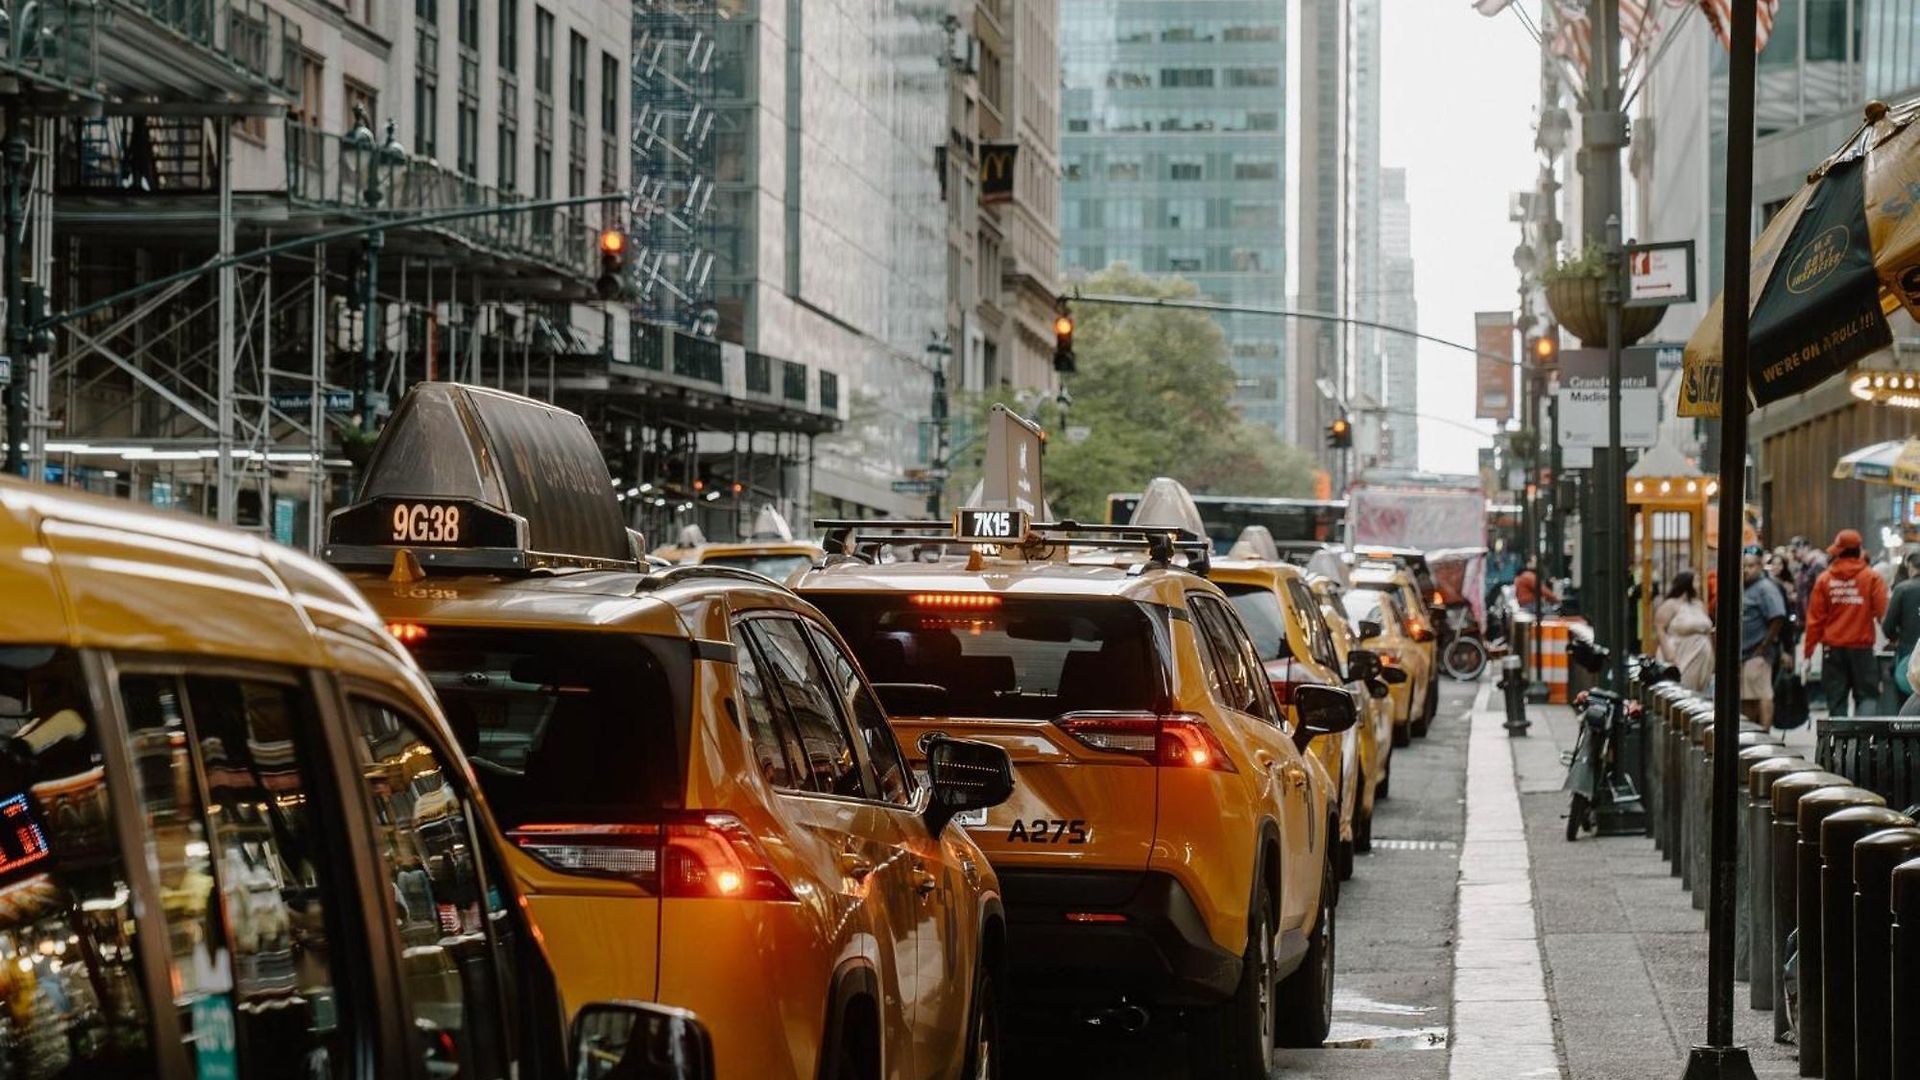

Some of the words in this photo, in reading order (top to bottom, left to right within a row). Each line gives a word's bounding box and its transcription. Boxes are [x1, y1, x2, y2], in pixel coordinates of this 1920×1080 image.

[1763, 352, 1801, 383] WE'RE
[1802, 341, 1821, 361] ON
[1570, 391, 1622, 402] Madis
[393, 503, 459, 542] 9G38
[973, 512, 1010, 536] 7K15
[1007, 819, 1087, 844] A275
